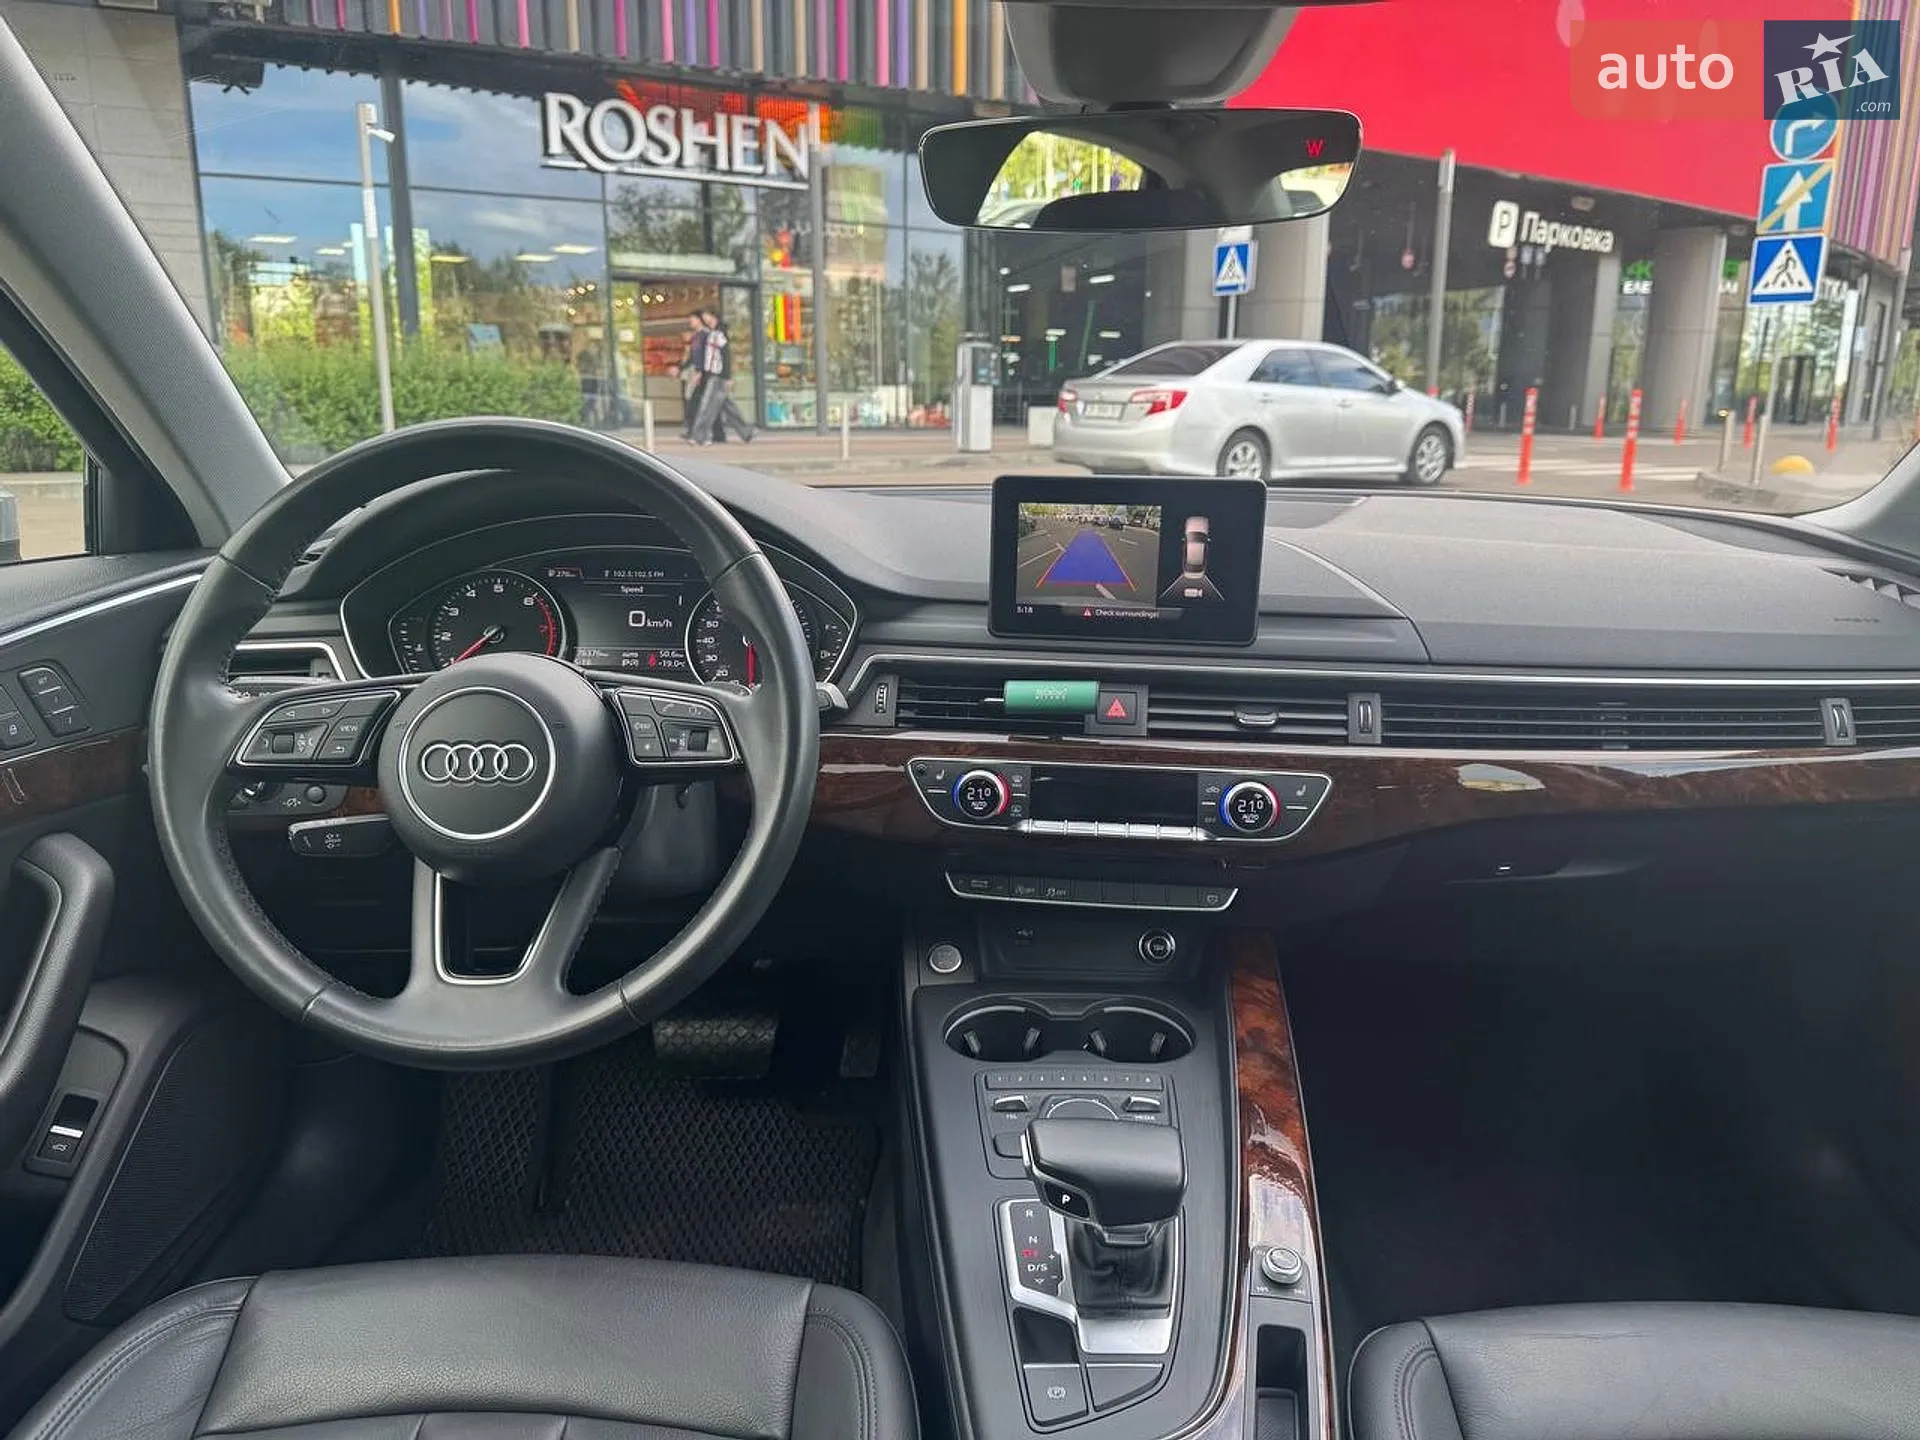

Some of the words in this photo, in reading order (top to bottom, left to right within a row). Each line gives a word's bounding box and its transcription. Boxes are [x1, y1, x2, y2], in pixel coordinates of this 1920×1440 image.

[543, 91, 810, 183] ROSHEN
[1305, 138, 1325, 160] W
[1520, 211, 1616, 253] Парковка
[466, 589, 477, 598] 4
[620, 585, 644, 595] Speed
[1095, 609, 1115, 618] Check
[628, 610, 646, 627] 0
[646, 618, 673, 628] km/h
[1062, 1194, 1071, 1204] P
[1026, 1209, 1033, 1218] R
[1029, 1236, 1038, 1244] N
[1027, 1263, 1048, 1272] D/S
